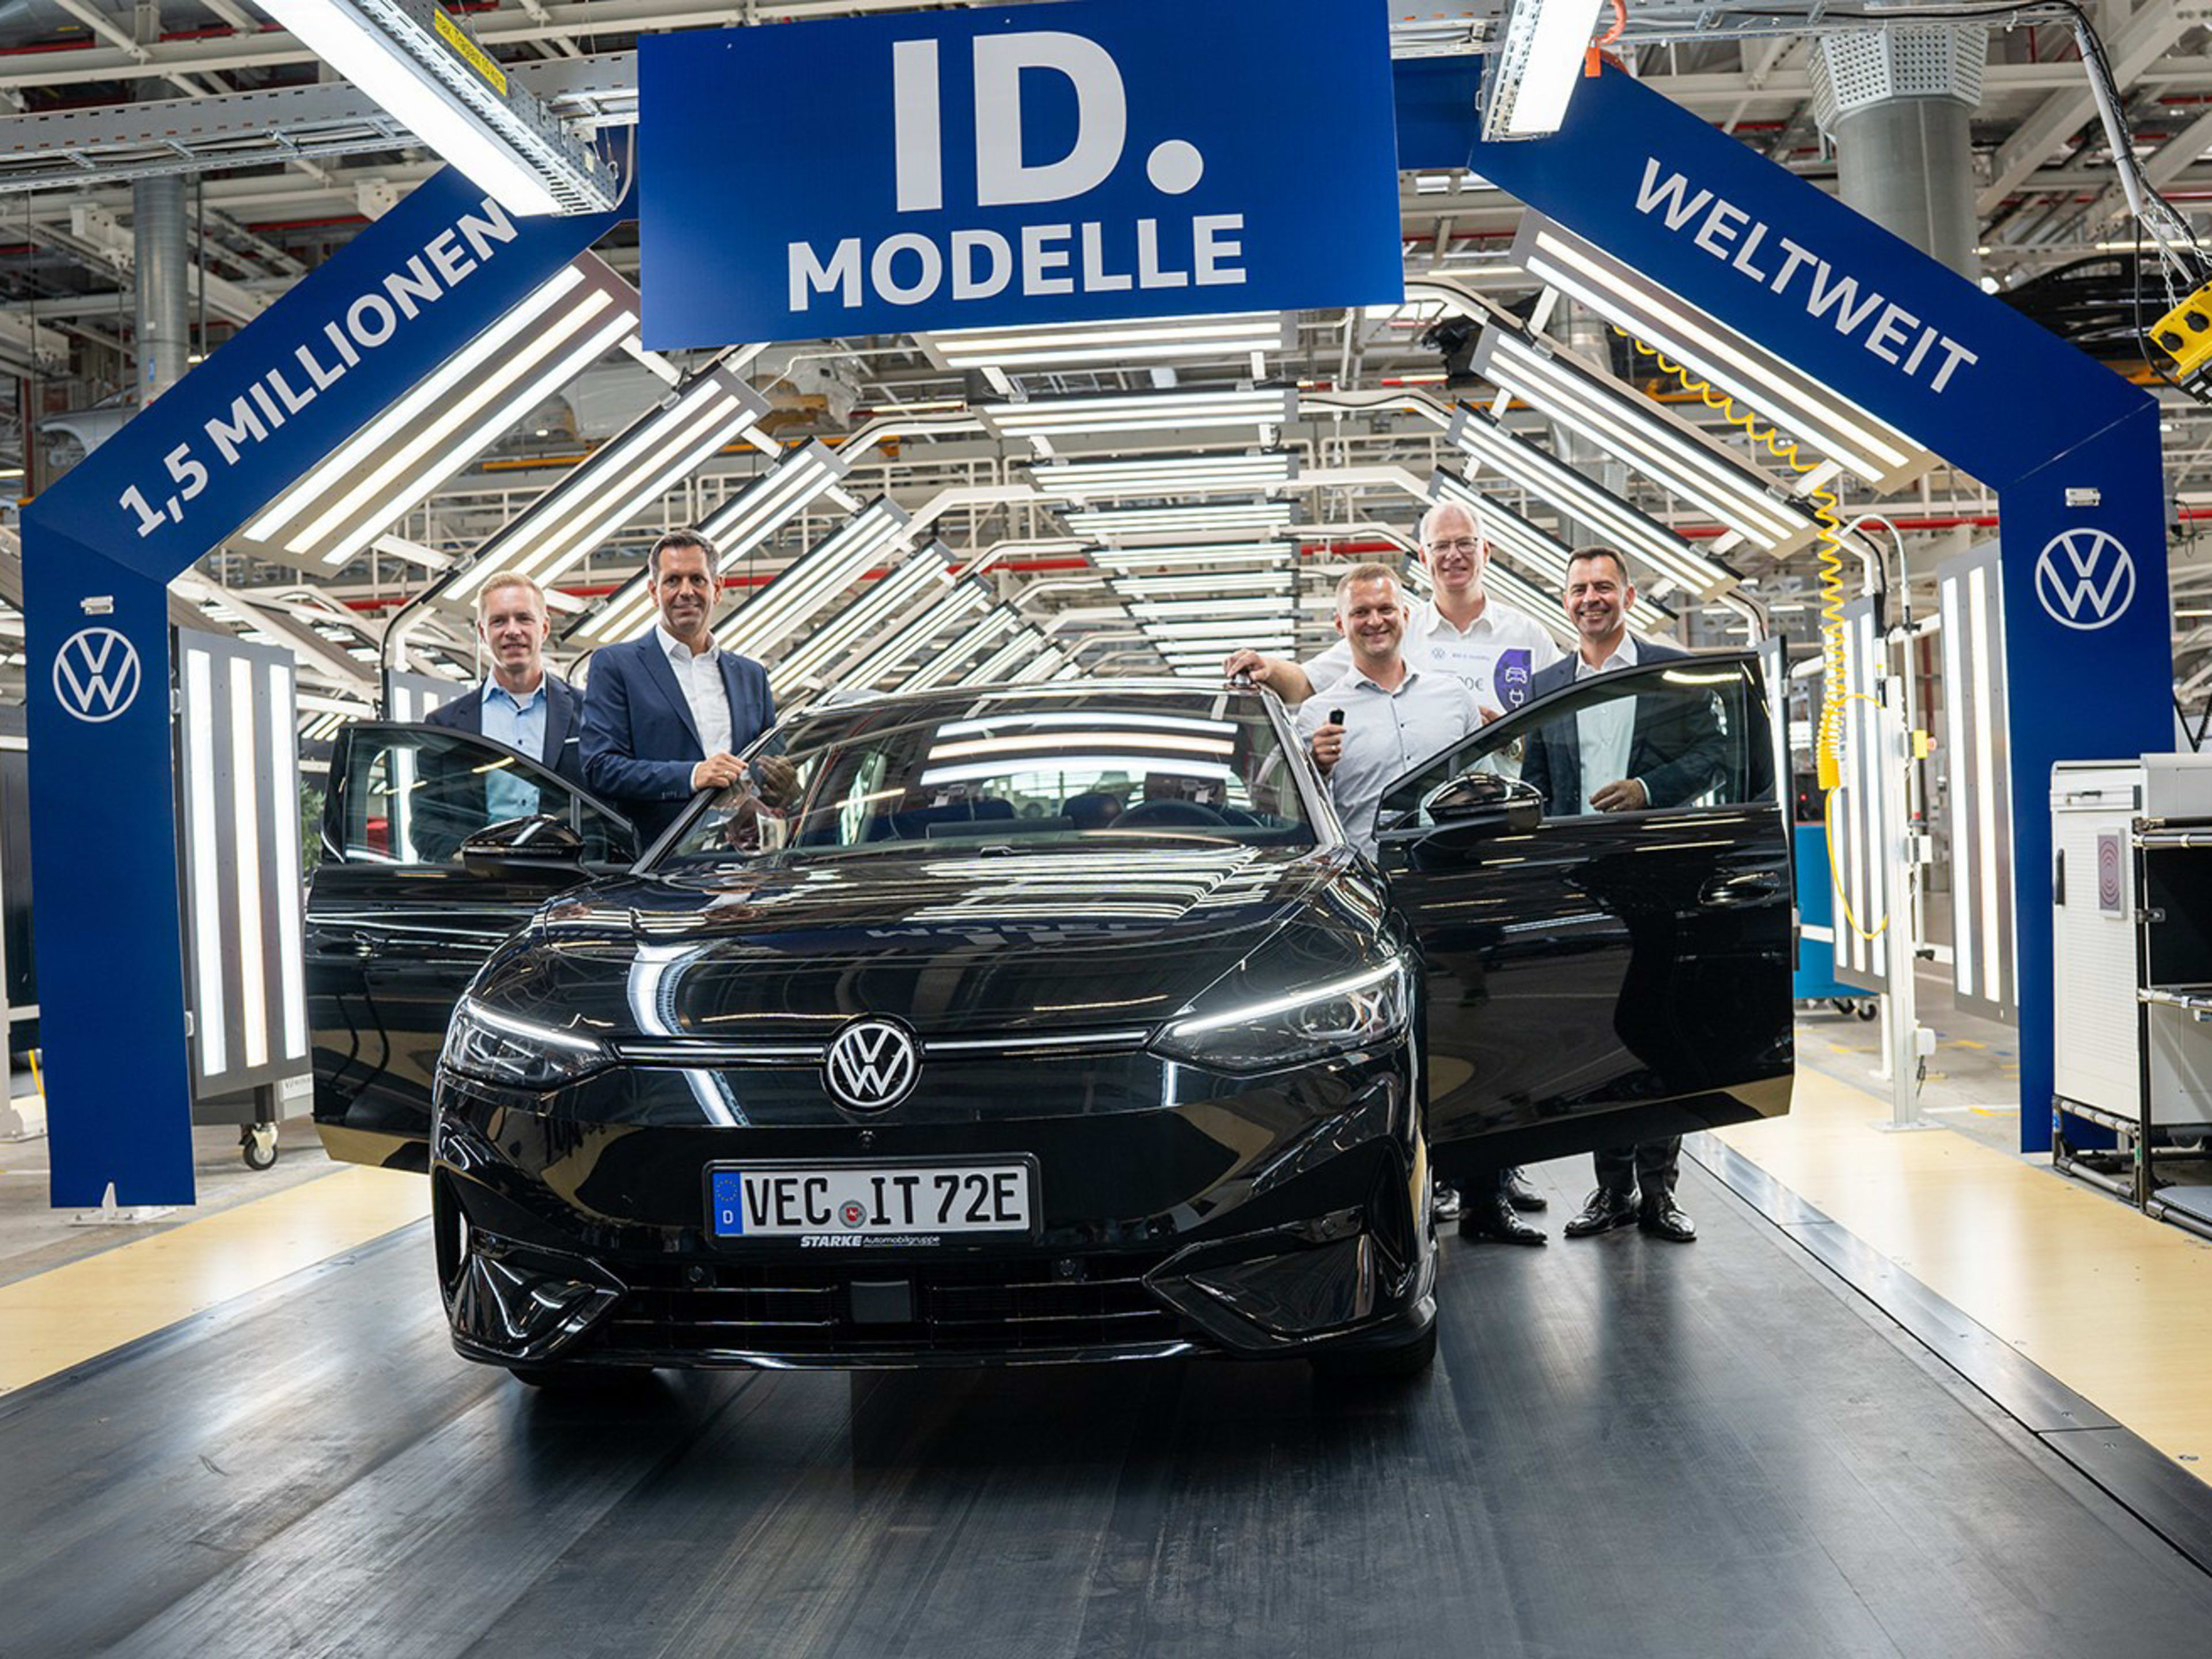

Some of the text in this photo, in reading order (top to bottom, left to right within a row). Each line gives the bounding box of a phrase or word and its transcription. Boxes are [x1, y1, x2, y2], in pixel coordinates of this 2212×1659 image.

[892, 31, 1204, 212] ID.
[787, 213, 1247, 312] MODELLE
[1635, 156, 1979, 393] WELTWEIT
[119, 196, 517, 537] 1,5 MILLIONEN
[744, 1173, 1022, 1226] VEC IT 72E
[800, 1235, 940, 1248] STARKE Automobilgruppe
